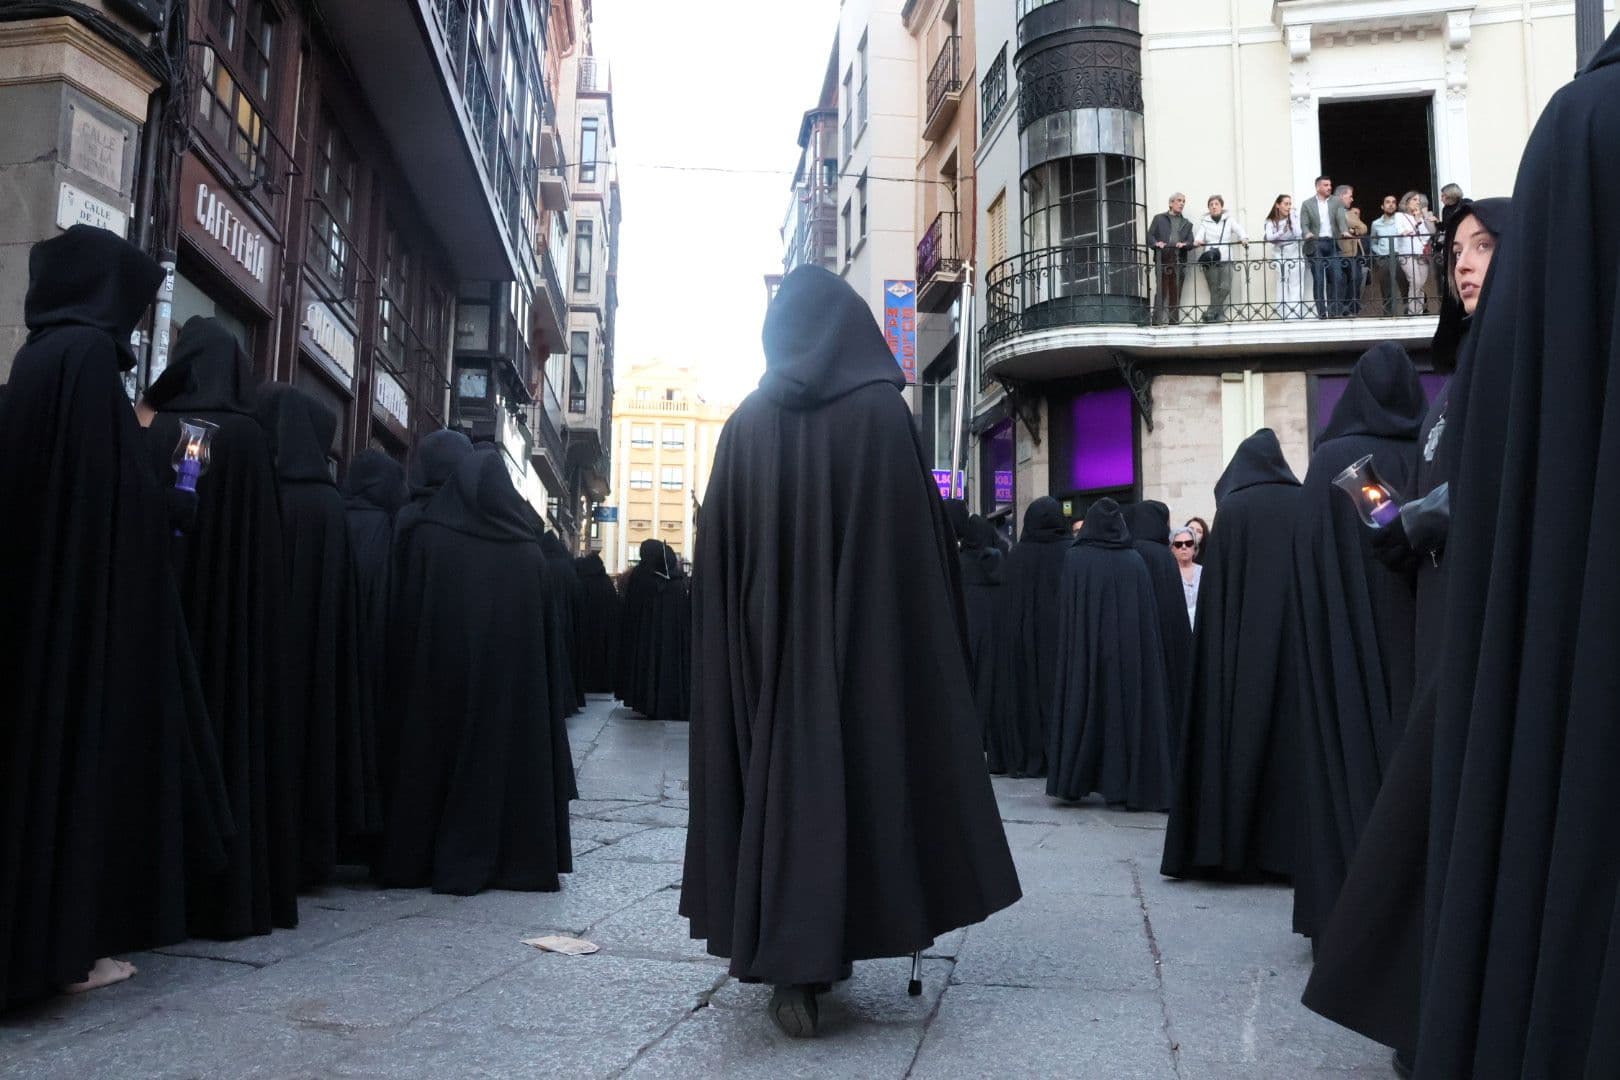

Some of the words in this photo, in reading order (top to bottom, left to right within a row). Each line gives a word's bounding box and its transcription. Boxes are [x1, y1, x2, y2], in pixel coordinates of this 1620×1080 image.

[80, 210, 91, 222] DE
[84, 201, 111, 221] CALLE
[197, 184, 264, 283] CAFETERÍA
[902, 308, 914, 383] BOLSOS
